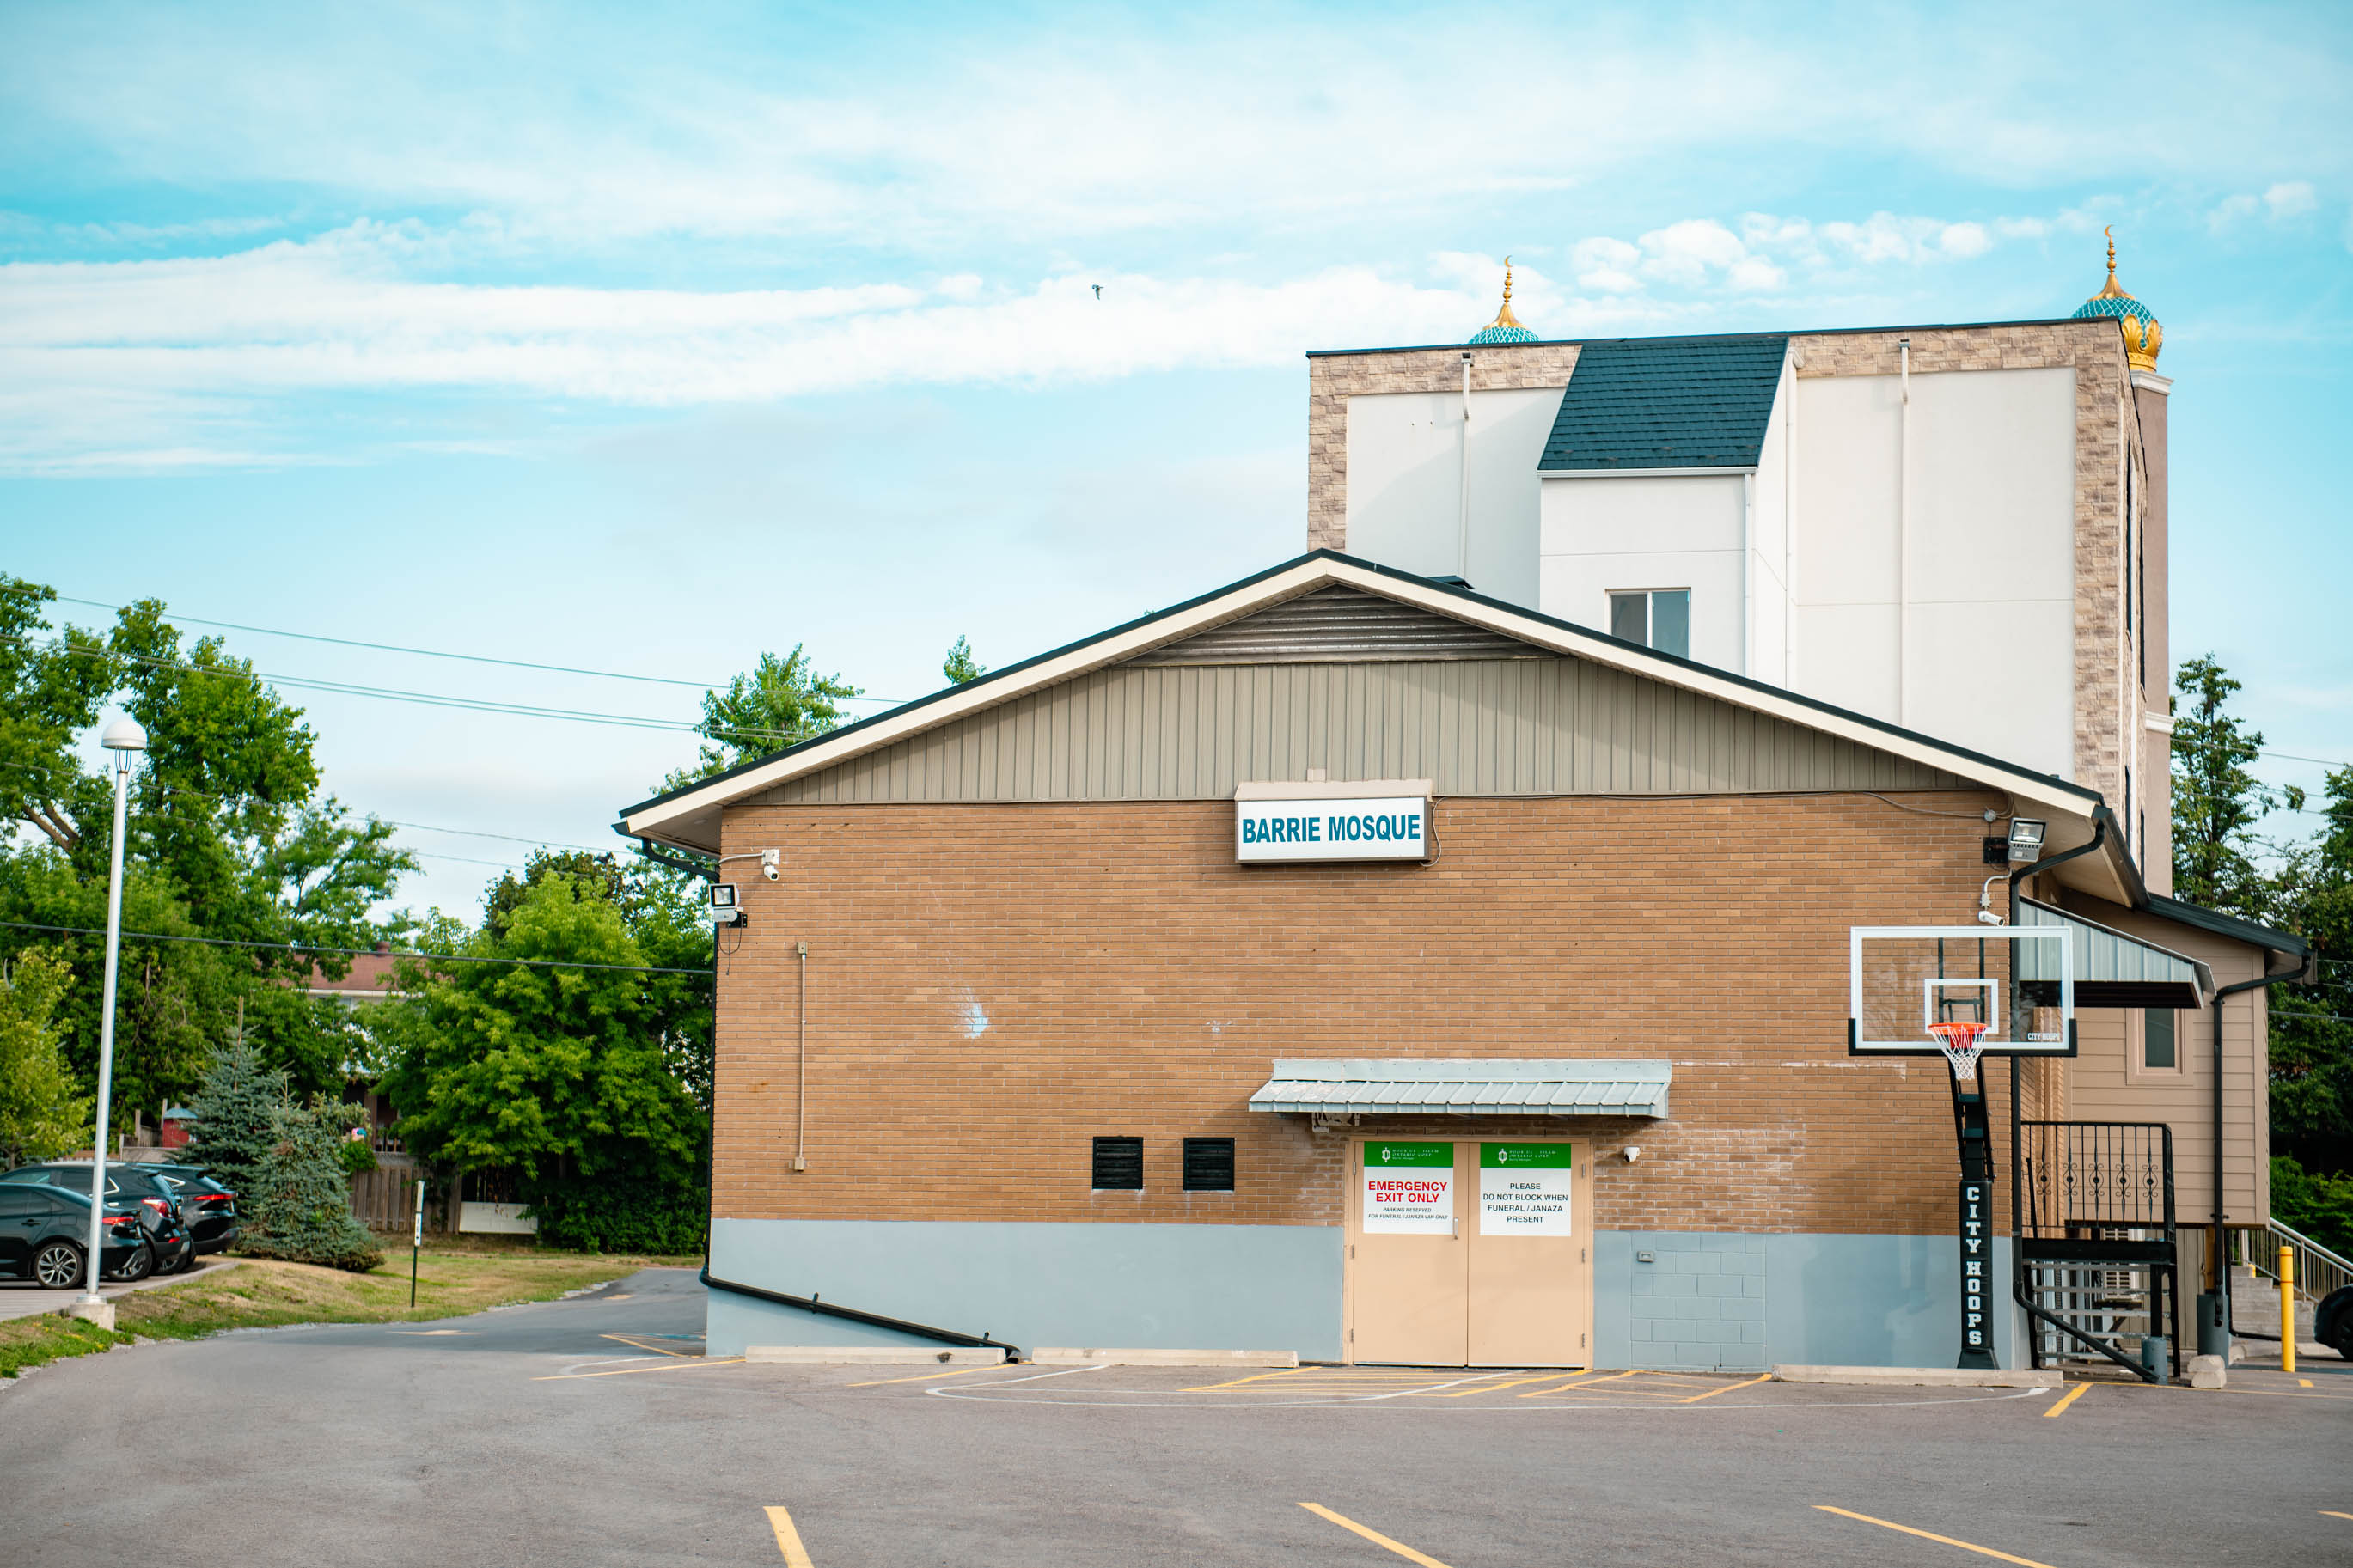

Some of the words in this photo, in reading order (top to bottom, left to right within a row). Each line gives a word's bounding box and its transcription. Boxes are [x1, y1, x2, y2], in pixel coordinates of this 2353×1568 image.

[1243, 816, 1321, 844] BARRIE
[1329, 815, 1421, 842] MOSQUE
[1368, 1181, 1447, 1191] EMERGENCY
[1376, 1193, 1403, 1202] EXIT
[1408, 1193, 1439, 1203] ONLY
[1965, 1187, 1981, 1253] CITY
[1966, 1261, 1983, 1345] HOOPS
